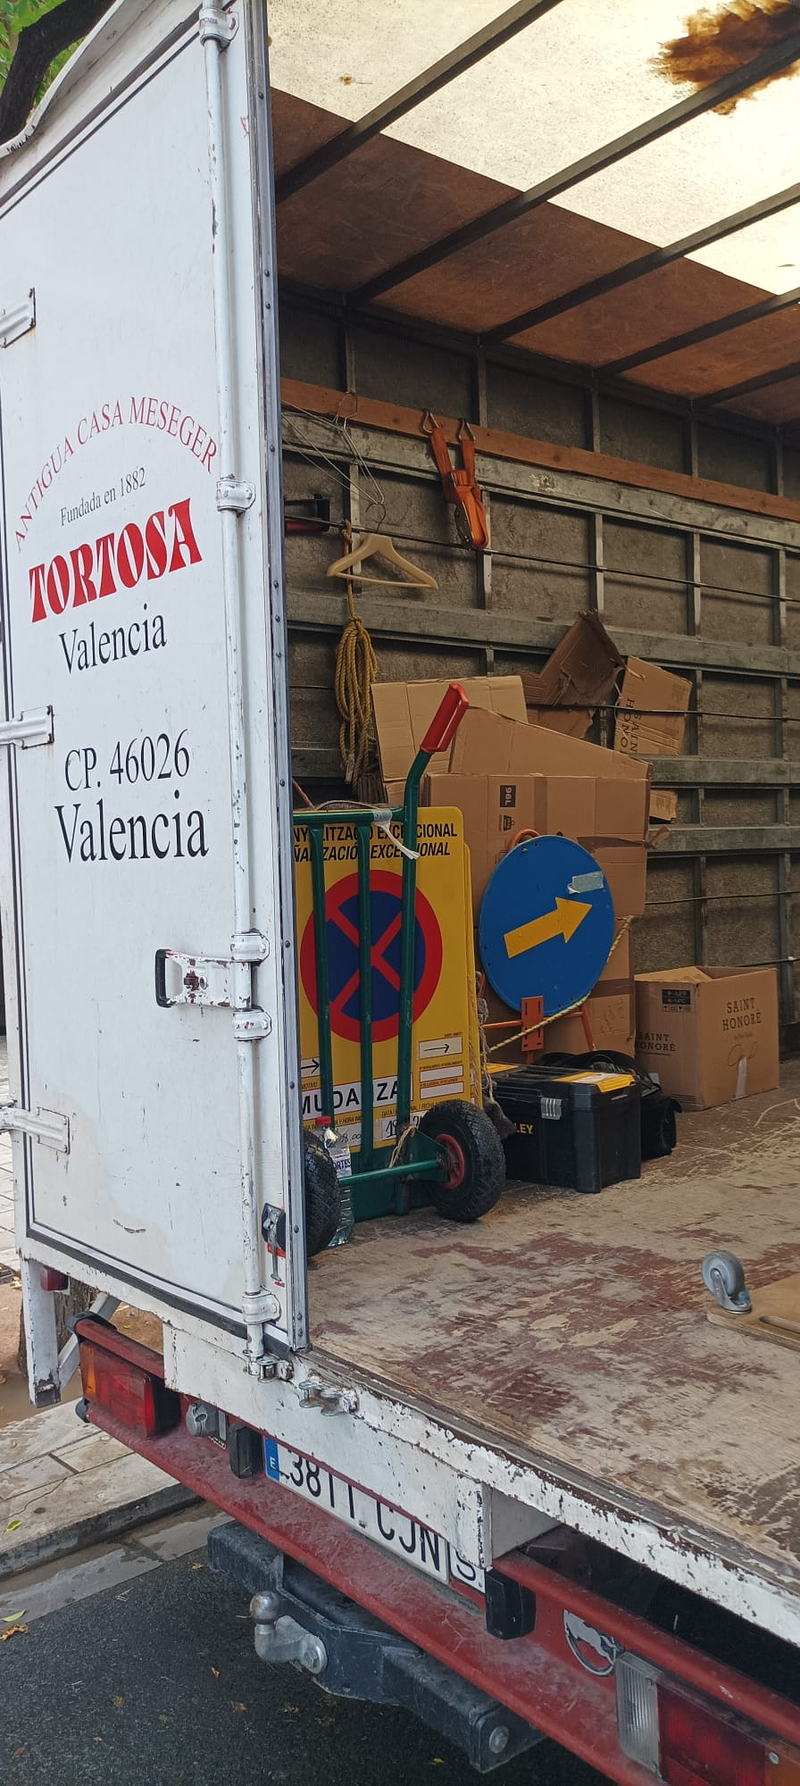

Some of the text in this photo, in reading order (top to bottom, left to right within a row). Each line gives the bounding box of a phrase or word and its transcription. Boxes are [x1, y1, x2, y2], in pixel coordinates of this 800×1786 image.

[14, 396, 217, 553] ANTIGUA CASA MESEGER
[60, 467, 146, 526] Fundada en 1882
[29, 498, 203, 623] TORTOSA
[58, 603, 167, 674] Valencia
[65, 728, 190, 792] CP. 46026
[54, 789, 209, 863] Valencia
[722, 1009, 761, 1031] HONORÉ
[727, 997, 755, 1014] SAINT
[302, 1080, 398, 1115] MUDAZA
[269, 1456, 276, 1471] E
